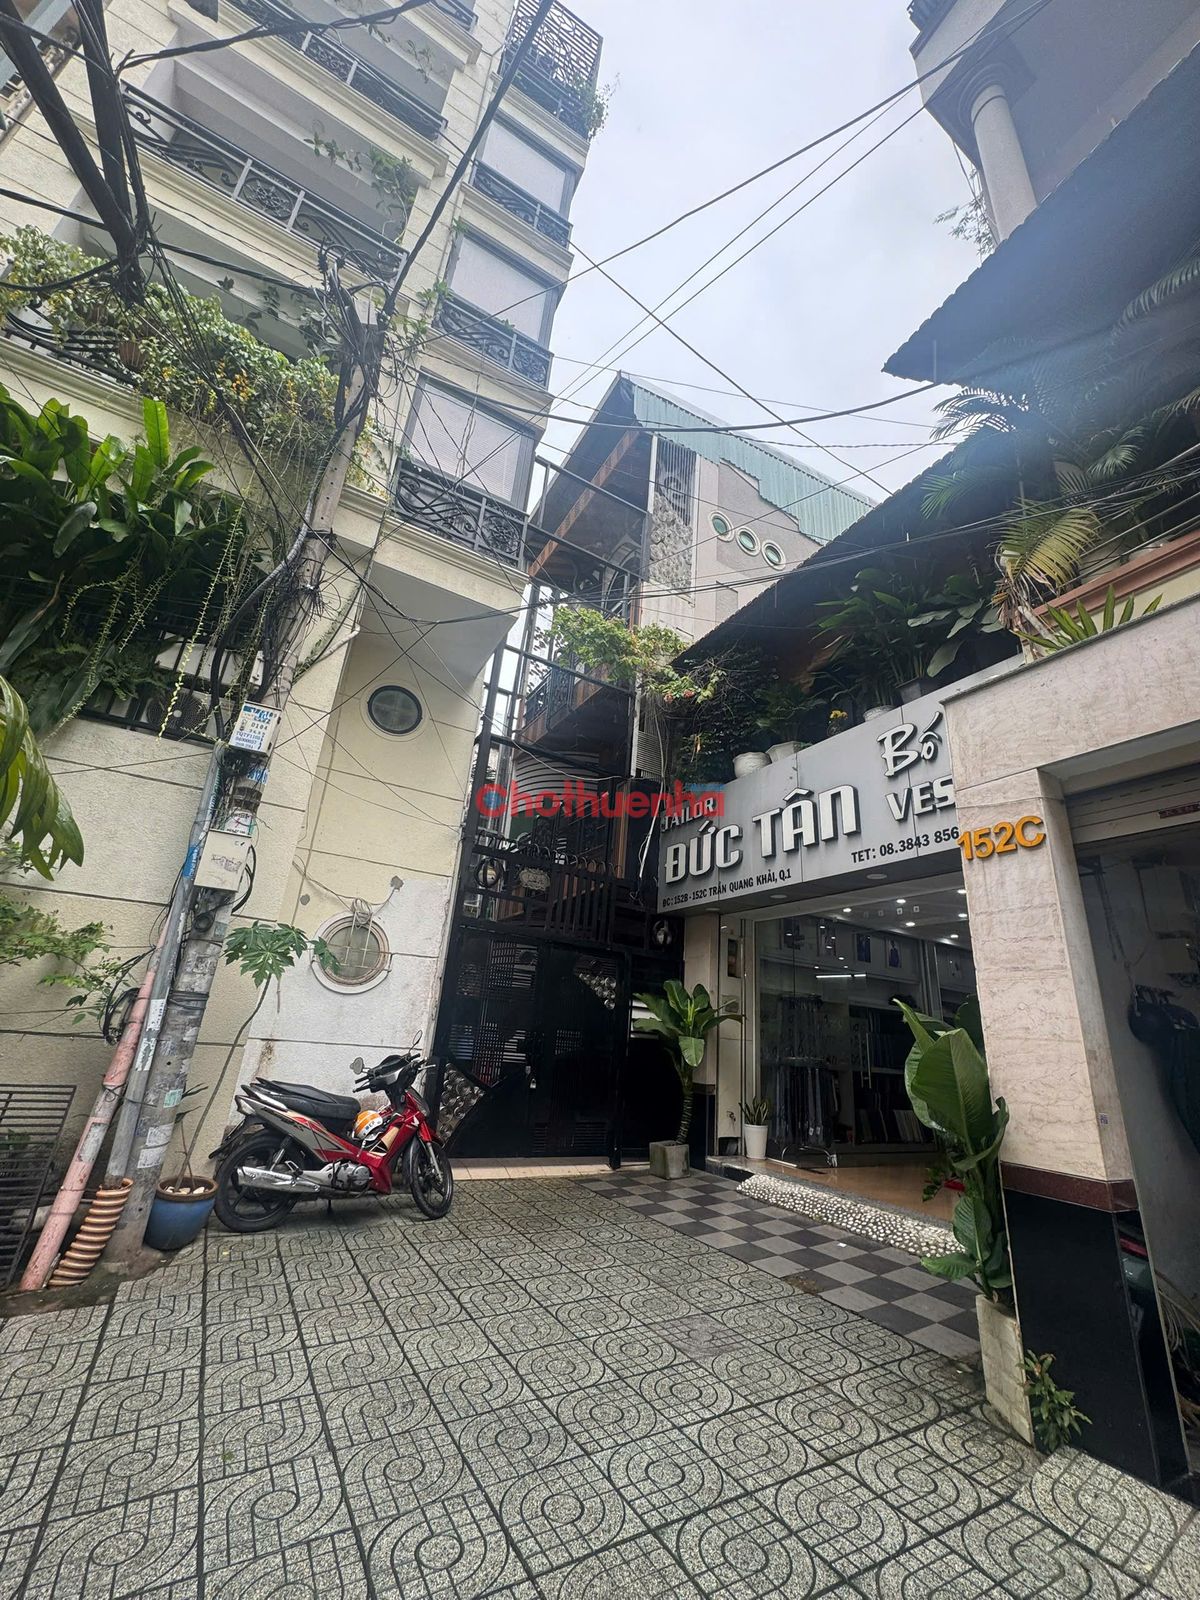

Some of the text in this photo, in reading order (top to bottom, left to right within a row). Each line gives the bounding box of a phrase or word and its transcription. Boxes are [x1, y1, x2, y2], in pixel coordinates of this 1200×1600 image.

[877, 711, 942, 777] Bố
[665, 785, 859, 884] ĐỨC TÂN
[880, 834, 930, 857] 08.3843
[934, 826, 959, 844] 856
[957, 815, 1046, 860] 152C
[729, 877, 753, 892] QUANG
[779, 868, 792, 881] Q.1
